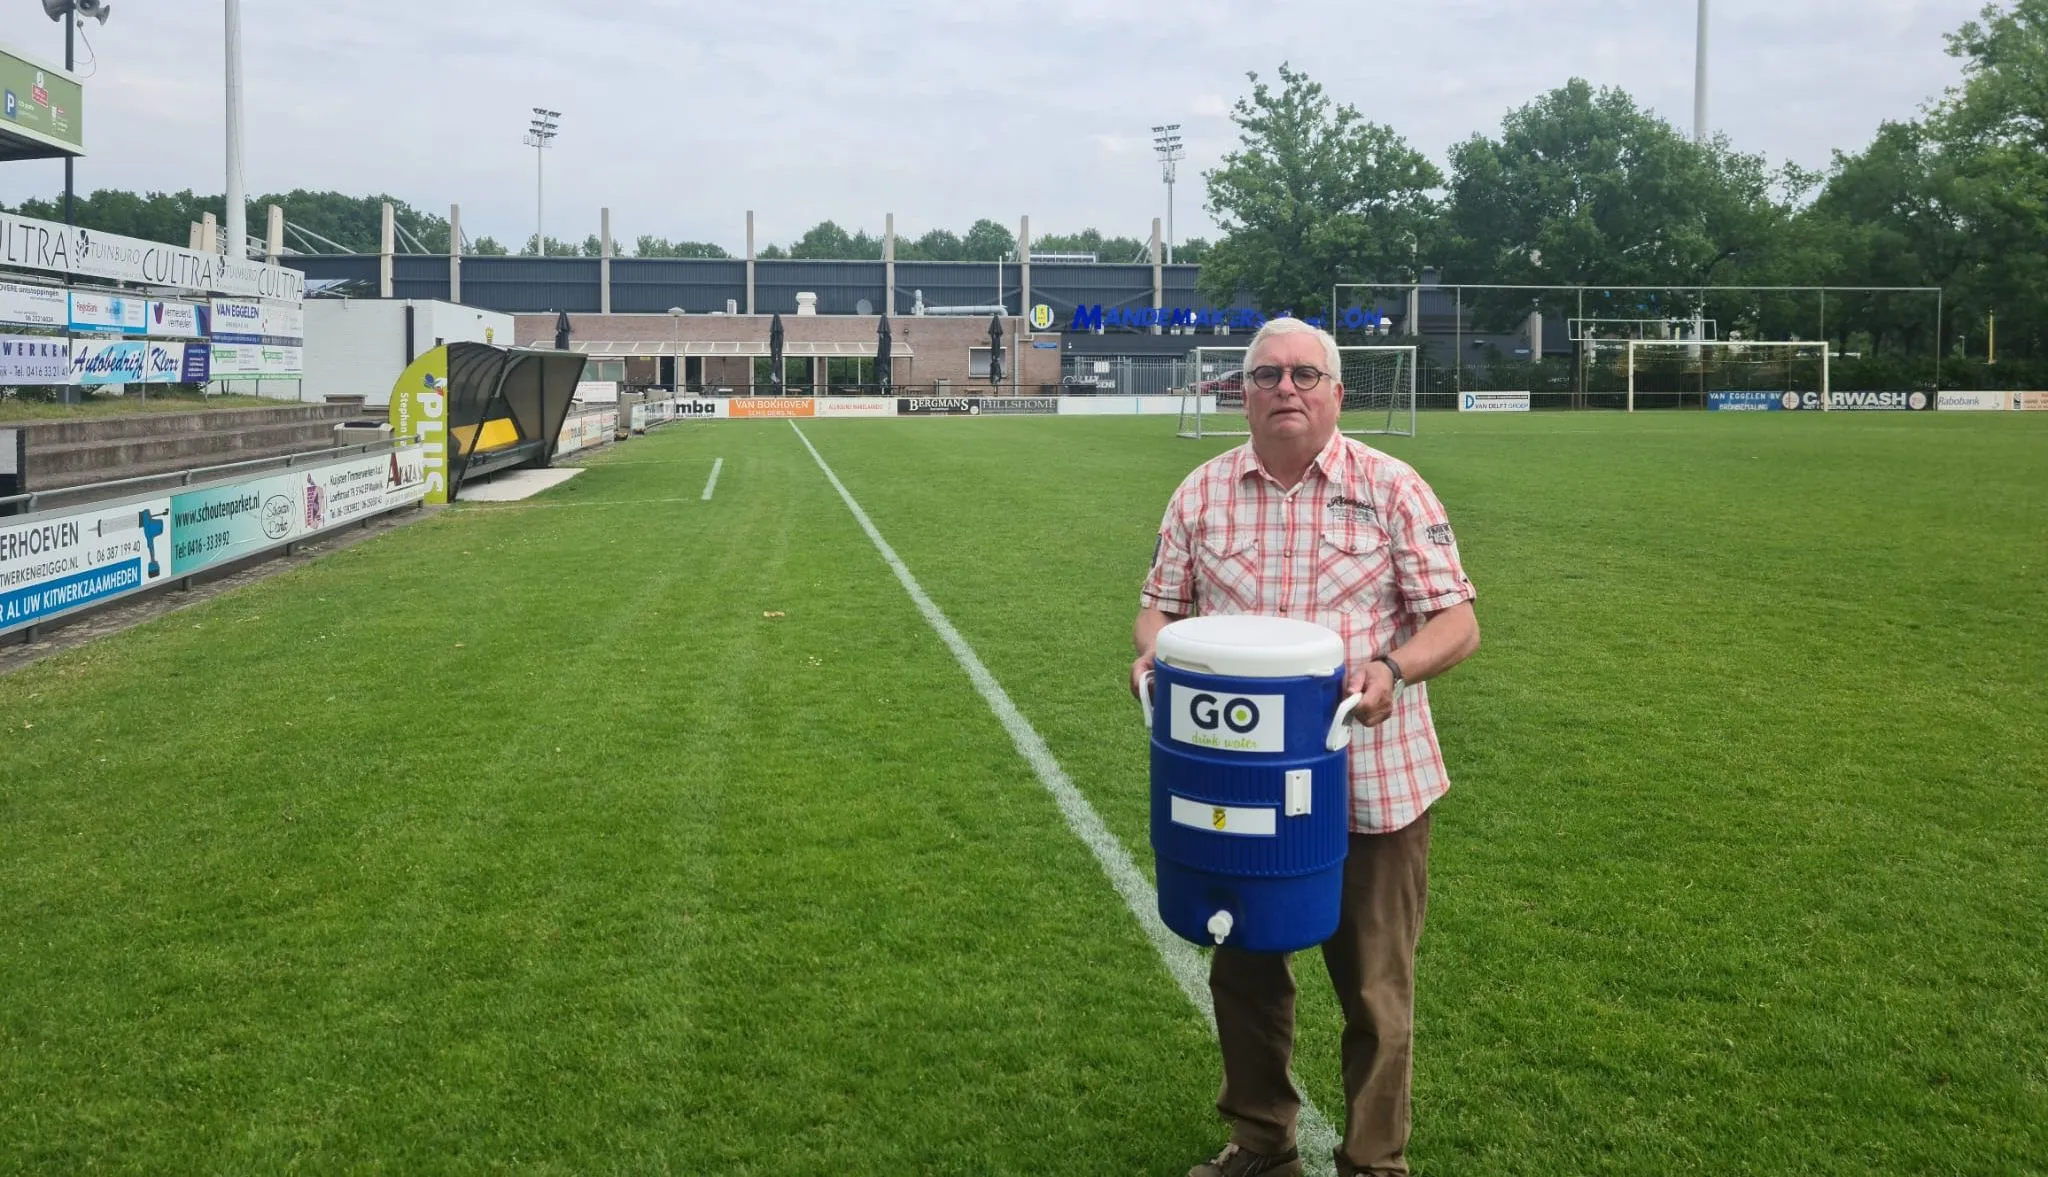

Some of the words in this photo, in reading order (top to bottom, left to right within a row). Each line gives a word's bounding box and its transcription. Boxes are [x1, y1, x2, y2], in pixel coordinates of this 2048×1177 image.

[0, 221, 69, 269] LTRA
[142, 248, 212, 288] CULTRA
[257, 267, 303, 303] CULTRA
[216, 303, 231, 316] VAN
[231, 304, 260, 319] EGGELEN
[3, 341, 68, 357] WERKEN
[70, 345, 146, 379] Autobedrijf
[676, 400, 715, 414] mba
[736, 399, 754, 409] VAN
[757, 399, 810, 409] BOKHOVEN
[910, 398, 969, 411] BERGMANS
[1729, 392, 1766, 400] EGGELEN
[1937, 396, 1980, 406] Rabobank
[417, 392, 444, 493] PLUS
[175, 490, 260, 528] www.schoutenparket.nl
[0, 521, 79, 562] ERHOEVEN
[187, 538, 202, 556] 0416
[0, 557, 79, 588] TWERKEN@ZIGGO.NL
[96, 551, 105, 563] 06
[106, 547, 119, 560] 387
[7, 605, 21, 621] AL
[23, 592, 41, 615] UW
[43, 566, 138, 608] KITWERKZAAMHEDEN
[1190, 693, 1260, 734] GO
